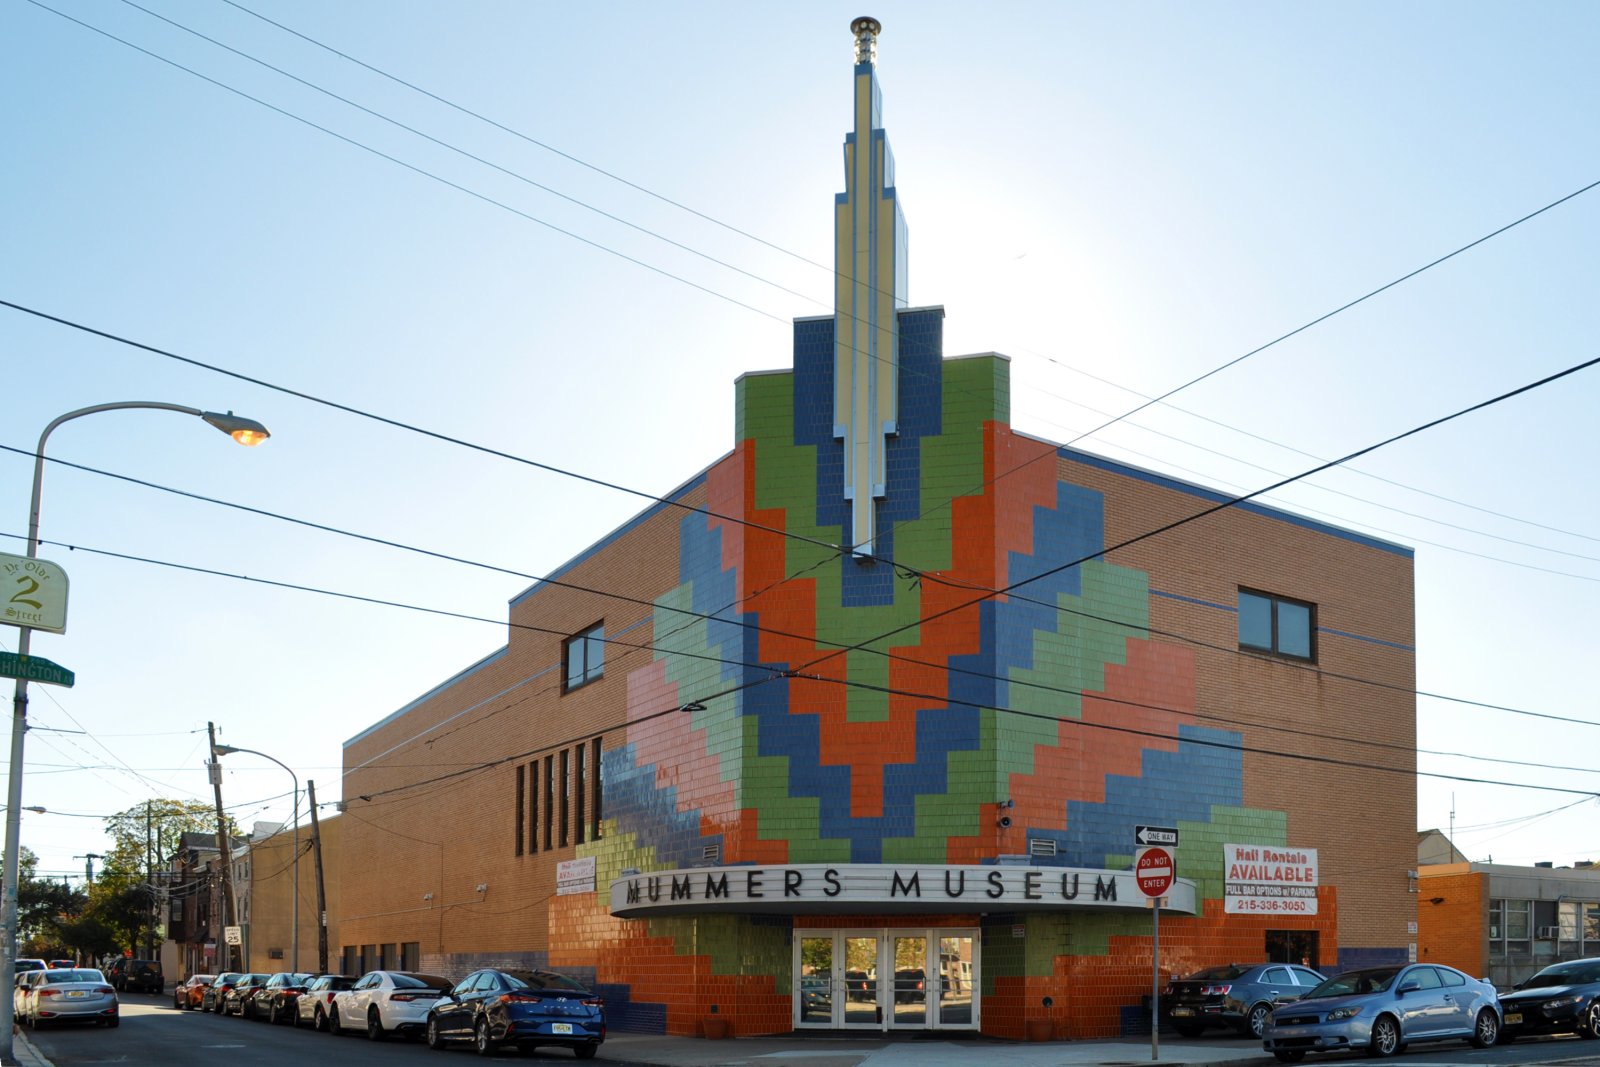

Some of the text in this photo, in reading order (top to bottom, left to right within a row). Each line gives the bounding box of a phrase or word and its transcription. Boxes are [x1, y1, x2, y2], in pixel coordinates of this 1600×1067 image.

[10, 575, 42, 610] 2
[5, 606, 42, 622] Street
[1147, 832, 1174, 841] ONE WAY
[1141, 856, 1168, 867] DO NOT
[1236, 848, 1307, 864] Hall Rentals
[1229, 863, 1314, 882] AVAILABLE
[626, 868, 1118, 904] MUMMERS MUSEUM
[1143, 879, 1165, 888] ENTER
[1226, 885, 1315, 897] FULL BAR OPTIONS w/ PARKING
[1238, 899, 1306, 911] 215-336-3050
